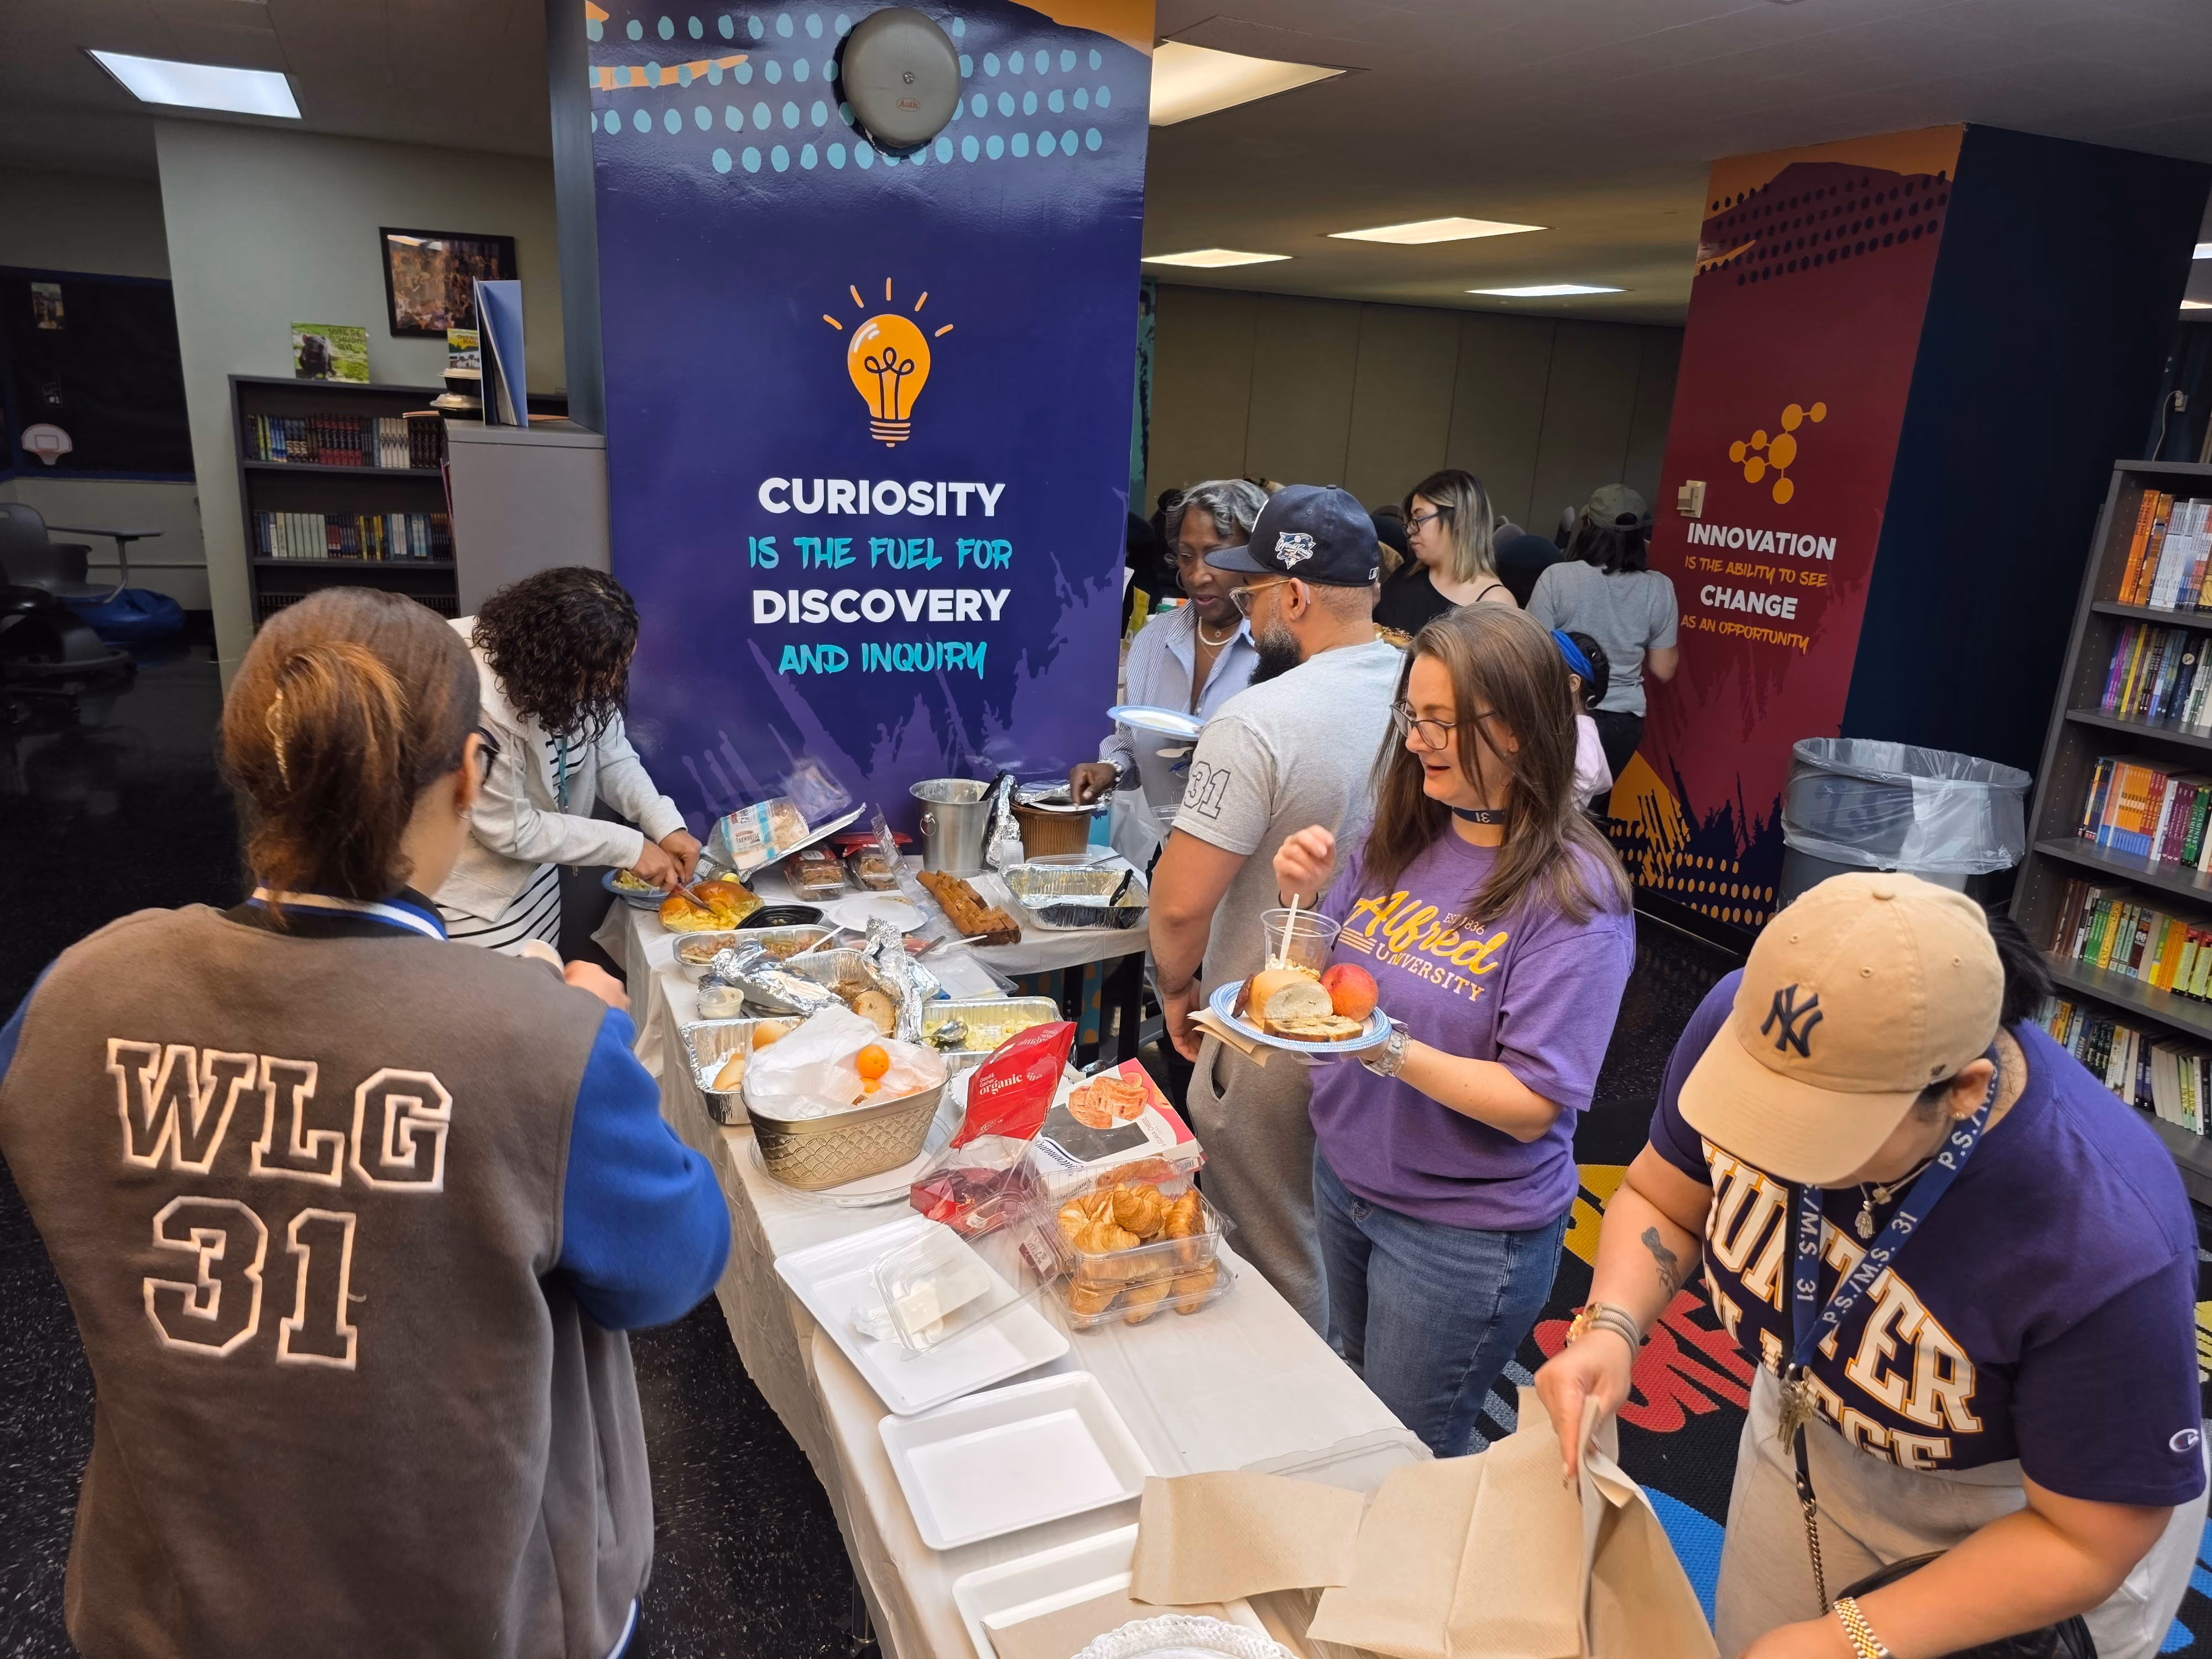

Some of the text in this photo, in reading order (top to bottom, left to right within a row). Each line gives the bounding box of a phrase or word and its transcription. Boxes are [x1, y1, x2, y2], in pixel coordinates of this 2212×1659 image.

[899, 100, 919, 109] Auth
[758, 477, 1006, 517] CURIOSITY
[749, 536, 1013, 570] IS THE FUEL FOR
[1687, 522, 1837, 560] INNOVATION
[1685, 555, 1828, 587] IS THE ABILITY TO SEE
[753, 589, 1011, 623] DISCOVERY
[1700, 585, 1798, 620] CHANGE
[1681, 615, 1809, 654] AS AN OPPORTUNITY
[779, 641, 987, 680] AND INQUIRY
[1183, 761, 1230, 820] 31
[1475, 811, 1490, 823] 31
[736, 833, 760, 844] FARMHOUSE
[1342, 890, 1508, 975] Alfred
[1375, 942, 1485, 1002] UNVERSITY
[1760, 983, 1823, 1058] NY
[979, 1073, 1022, 1095] organic
[107, 1037, 452, 1192] WLG
[1141, 1116, 1154, 1131] CHEESE
[1151, 1130, 1164, 1145] GUAVA
[144, 1195, 357, 1371] 31
[1822, 1211, 1917, 1323] P.S./M.S. 31
[1796, 1278, 1816, 1301] 31
